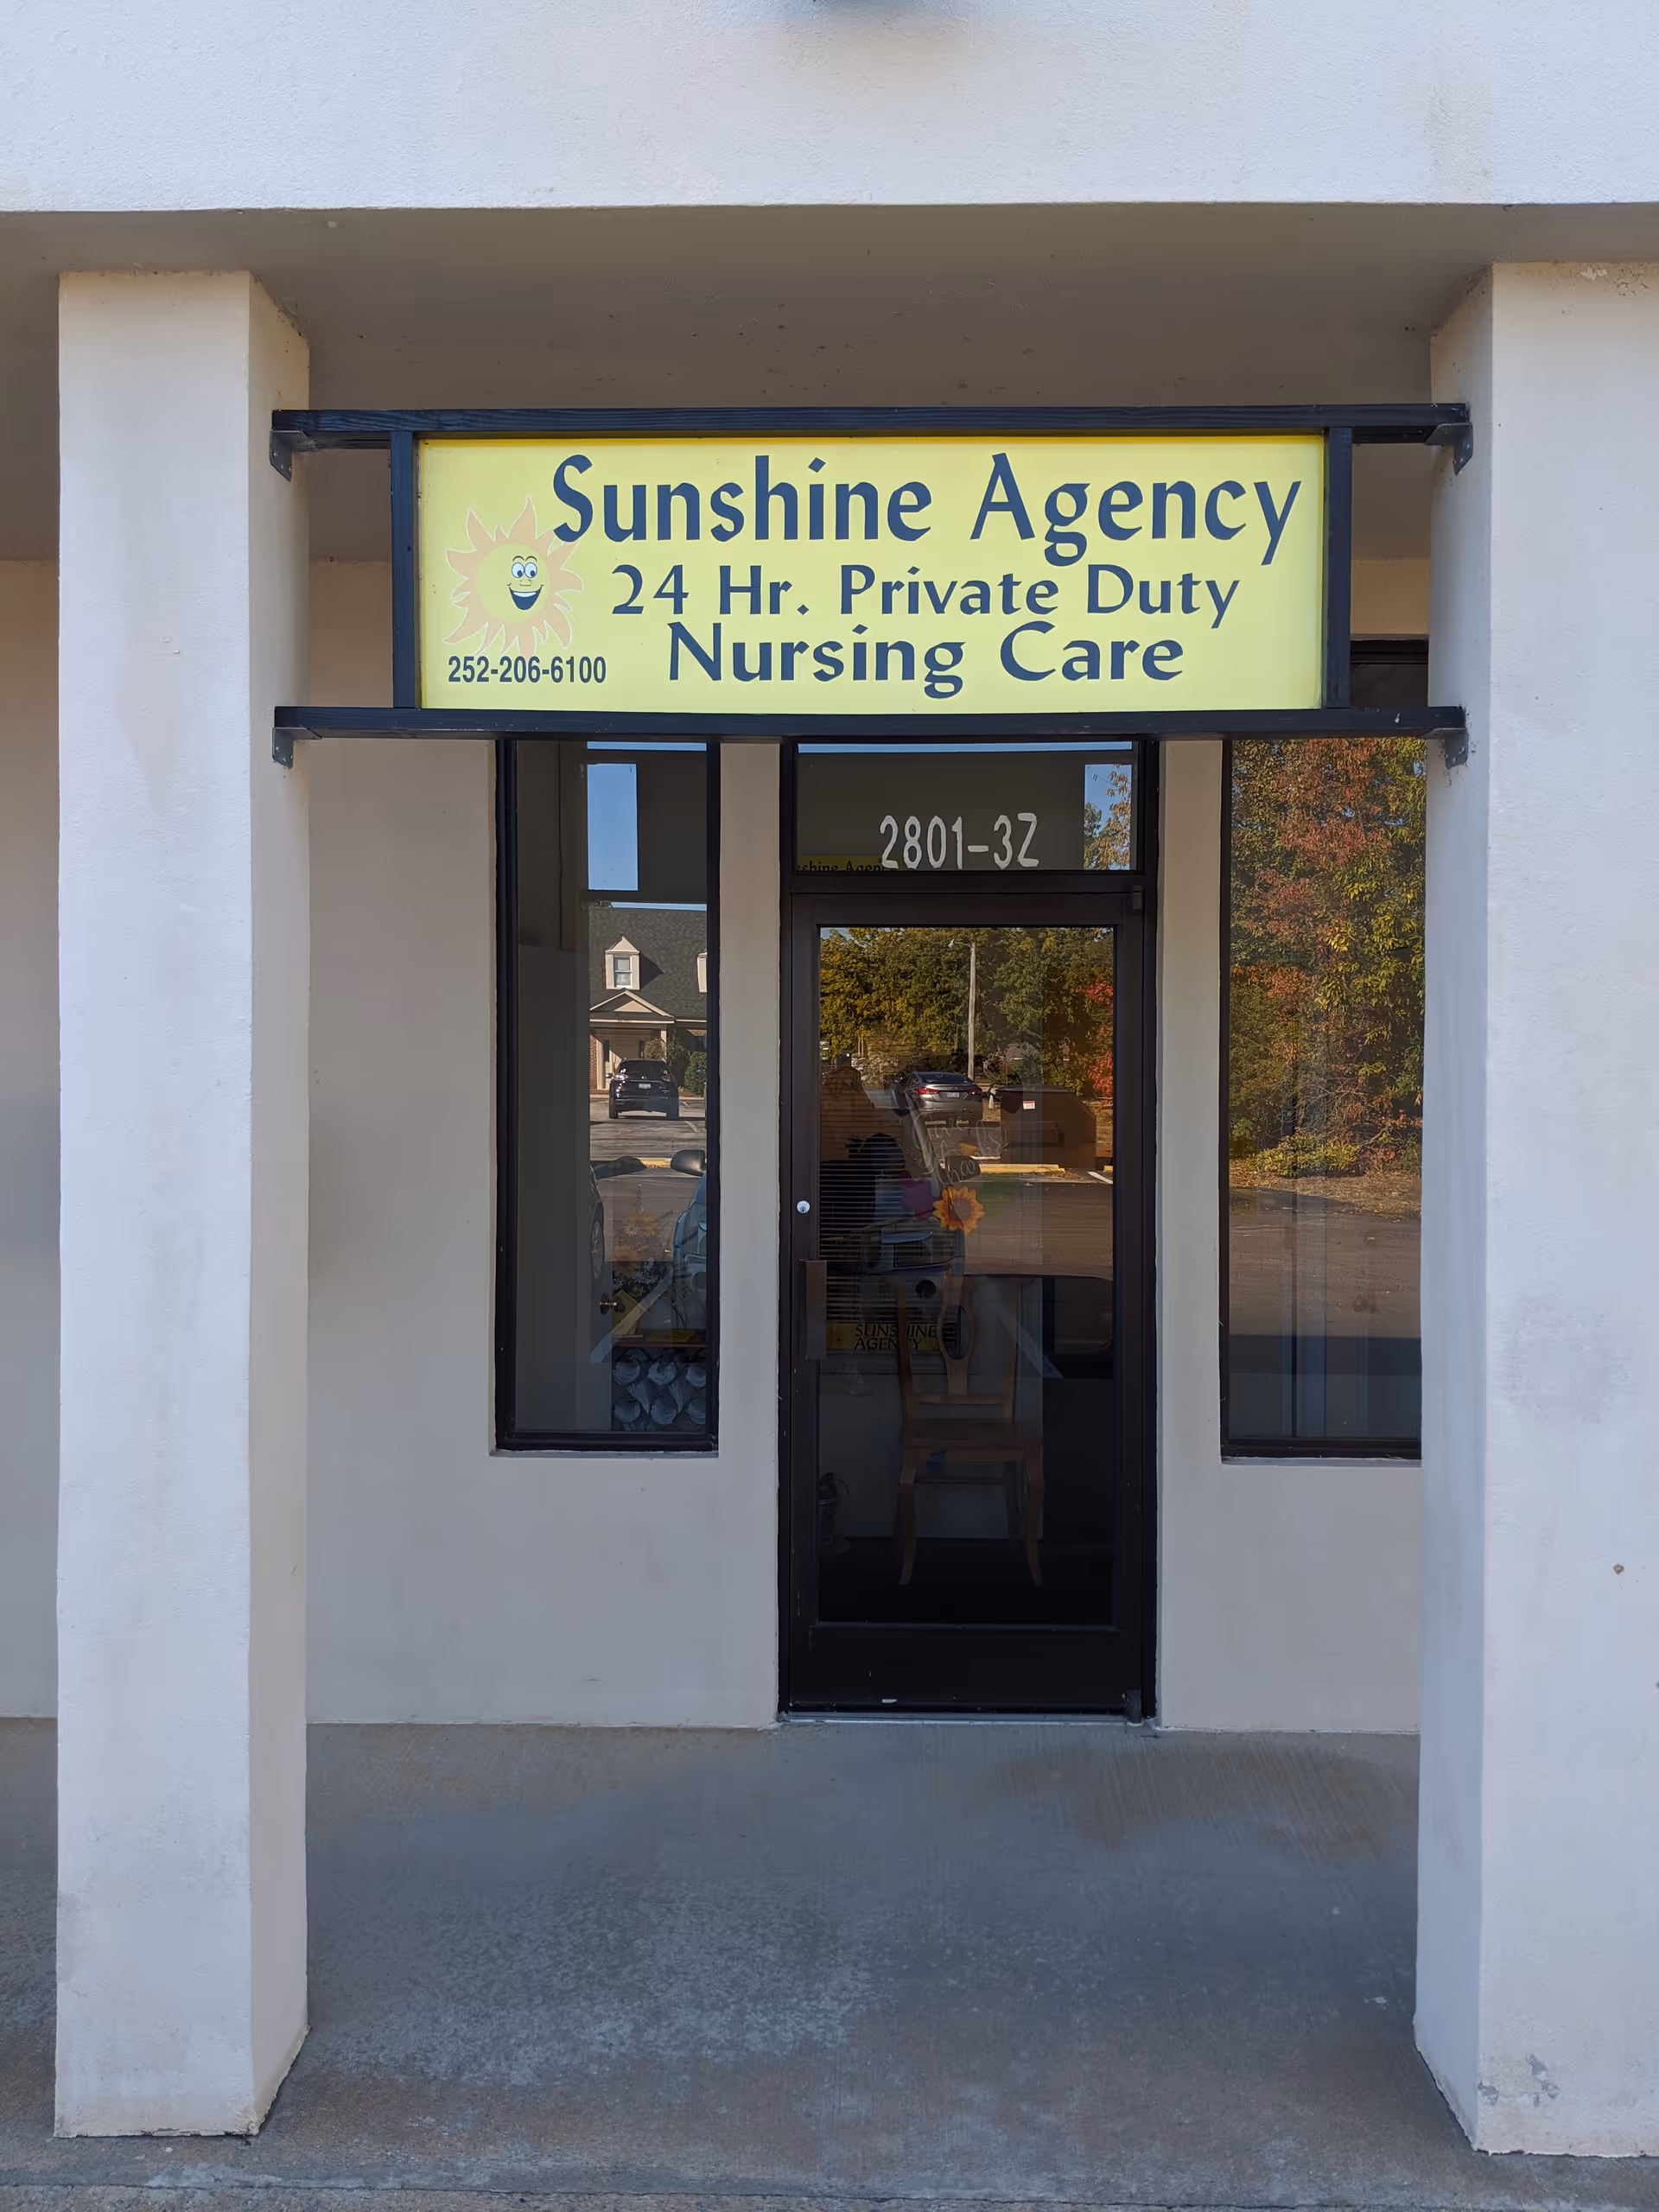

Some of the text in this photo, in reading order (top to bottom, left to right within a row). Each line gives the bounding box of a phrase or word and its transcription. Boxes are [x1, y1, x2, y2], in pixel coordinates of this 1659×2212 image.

[552, 452, 1302, 567] Sunshine Agency
[612, 563, 1240, 630] 24 Hr. Private Duty
[448, 656, 607, 684] 252-206-6100
[667, 620, 1184, 698] Nursing Care
[855, 1338, 923, 1350] AGENY
